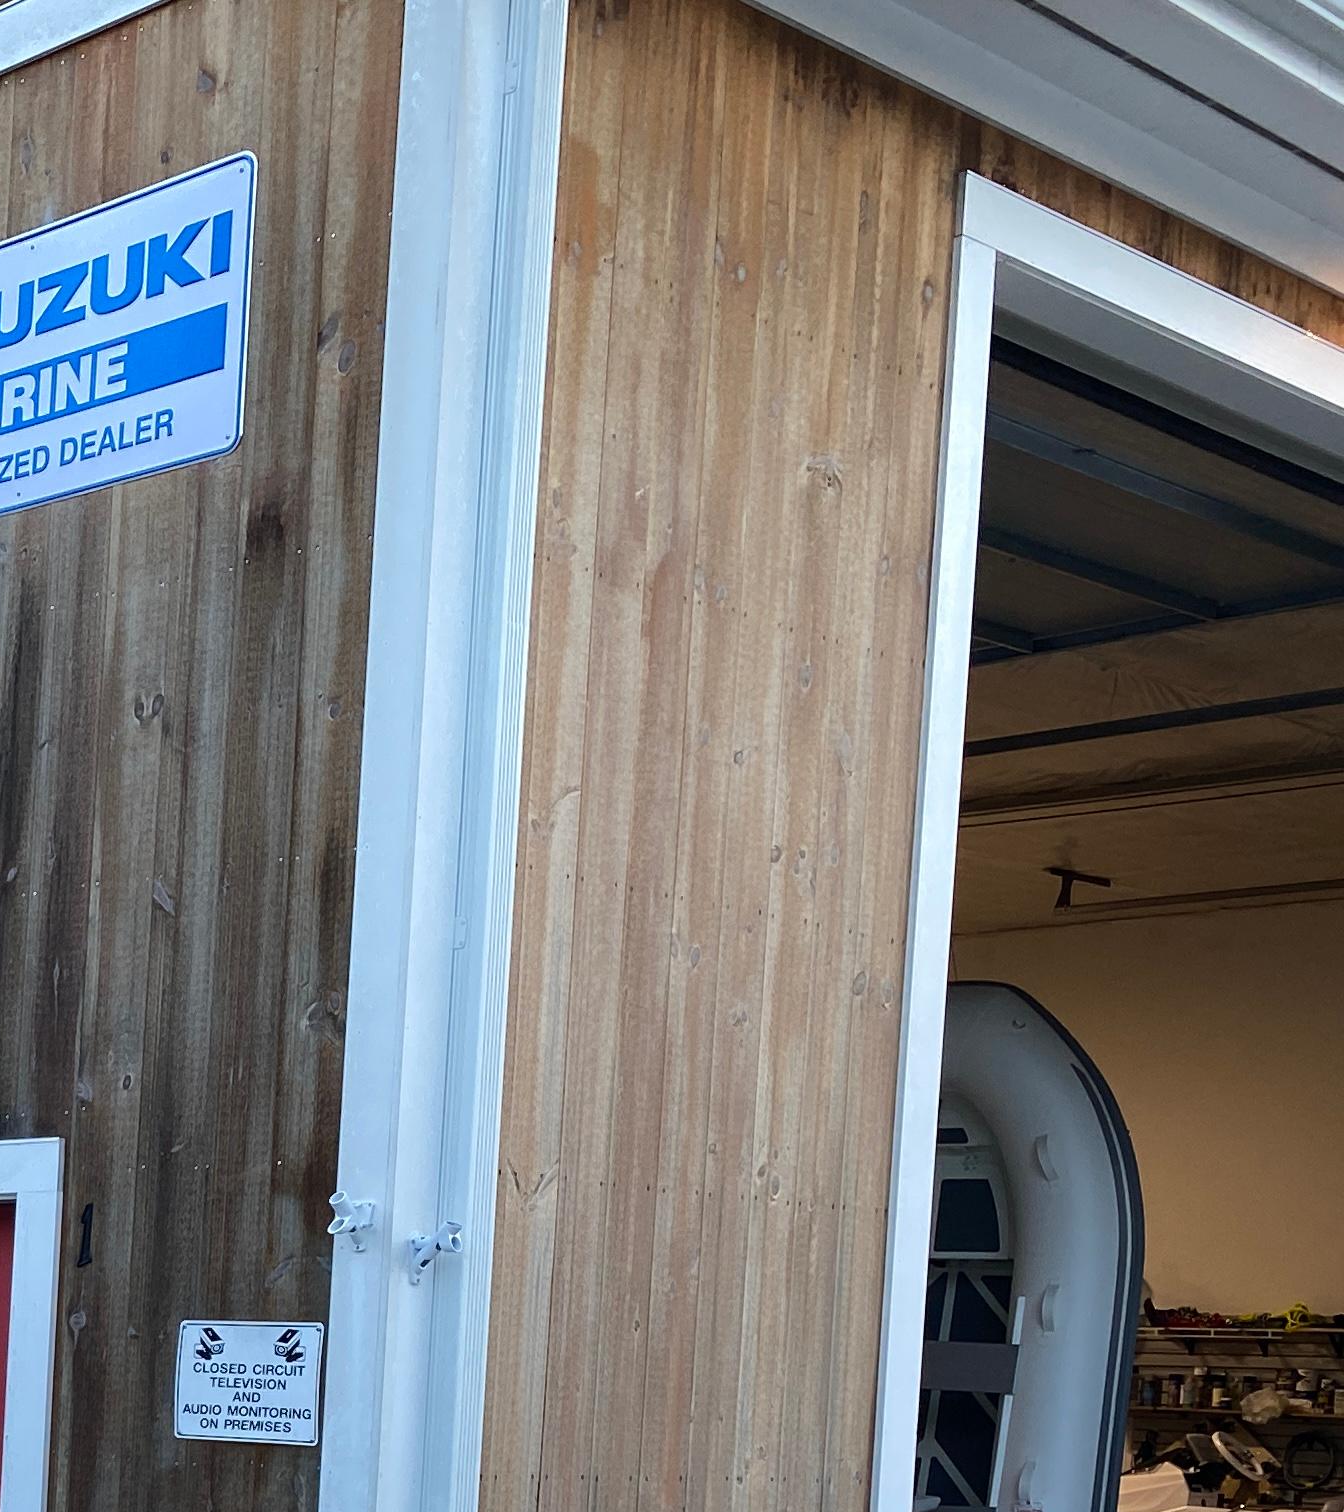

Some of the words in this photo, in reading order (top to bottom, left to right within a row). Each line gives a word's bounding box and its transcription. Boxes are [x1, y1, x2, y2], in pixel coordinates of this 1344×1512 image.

[59, 408, 174, 468] DEALER
[192, 1362, 247, 1375] CLOSED
[252, 1364, 306, 1377] CIRCUIT
[210, 1377, 287, 1390] TELEVISION
[232, 1391, 261, 1403] AND
[182, 1403, 222, 1415] AUDIO
[227, 1405, 312, 1420] MONITORING
[199, 1417, 218, 1429] ON
[223, 1419, 292, 1433] PREMISES
